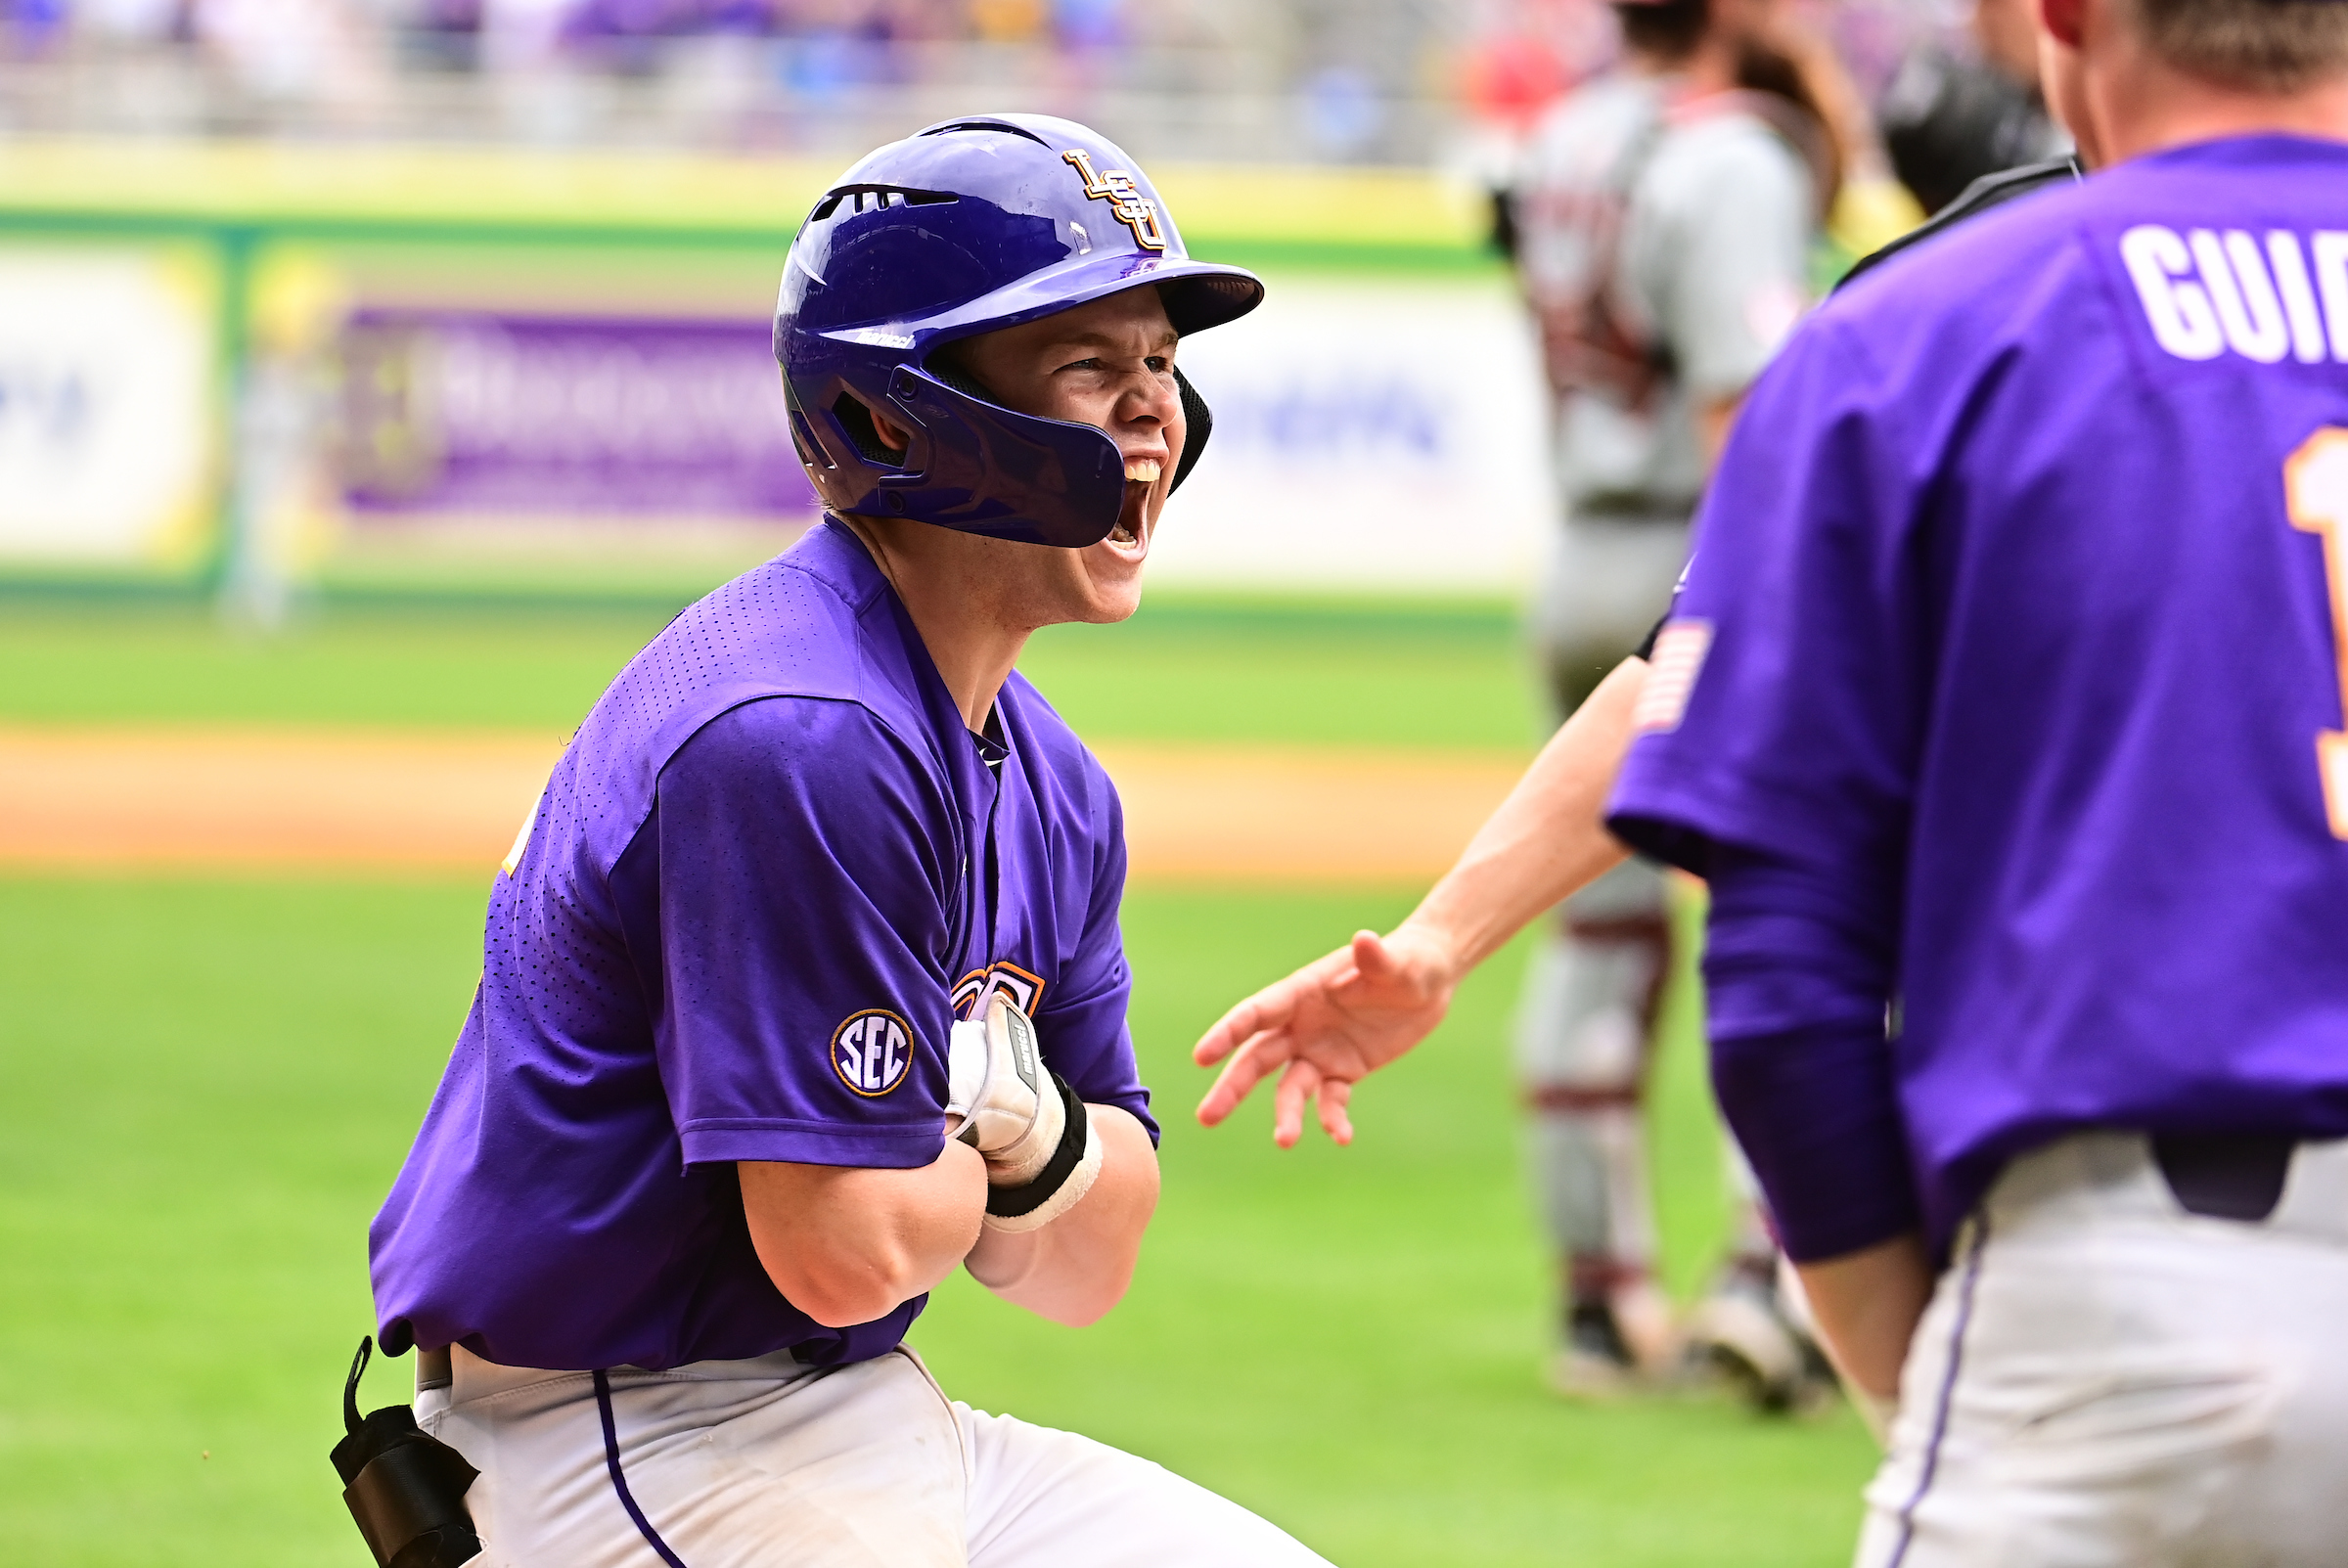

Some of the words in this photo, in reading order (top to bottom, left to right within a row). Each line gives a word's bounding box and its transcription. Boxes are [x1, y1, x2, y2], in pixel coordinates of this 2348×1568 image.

[1061, 149, 1167, 250] LSU
[838, 1015, 907, 1089] SEC
[1014, 1023, 1034, 1076] marucci
